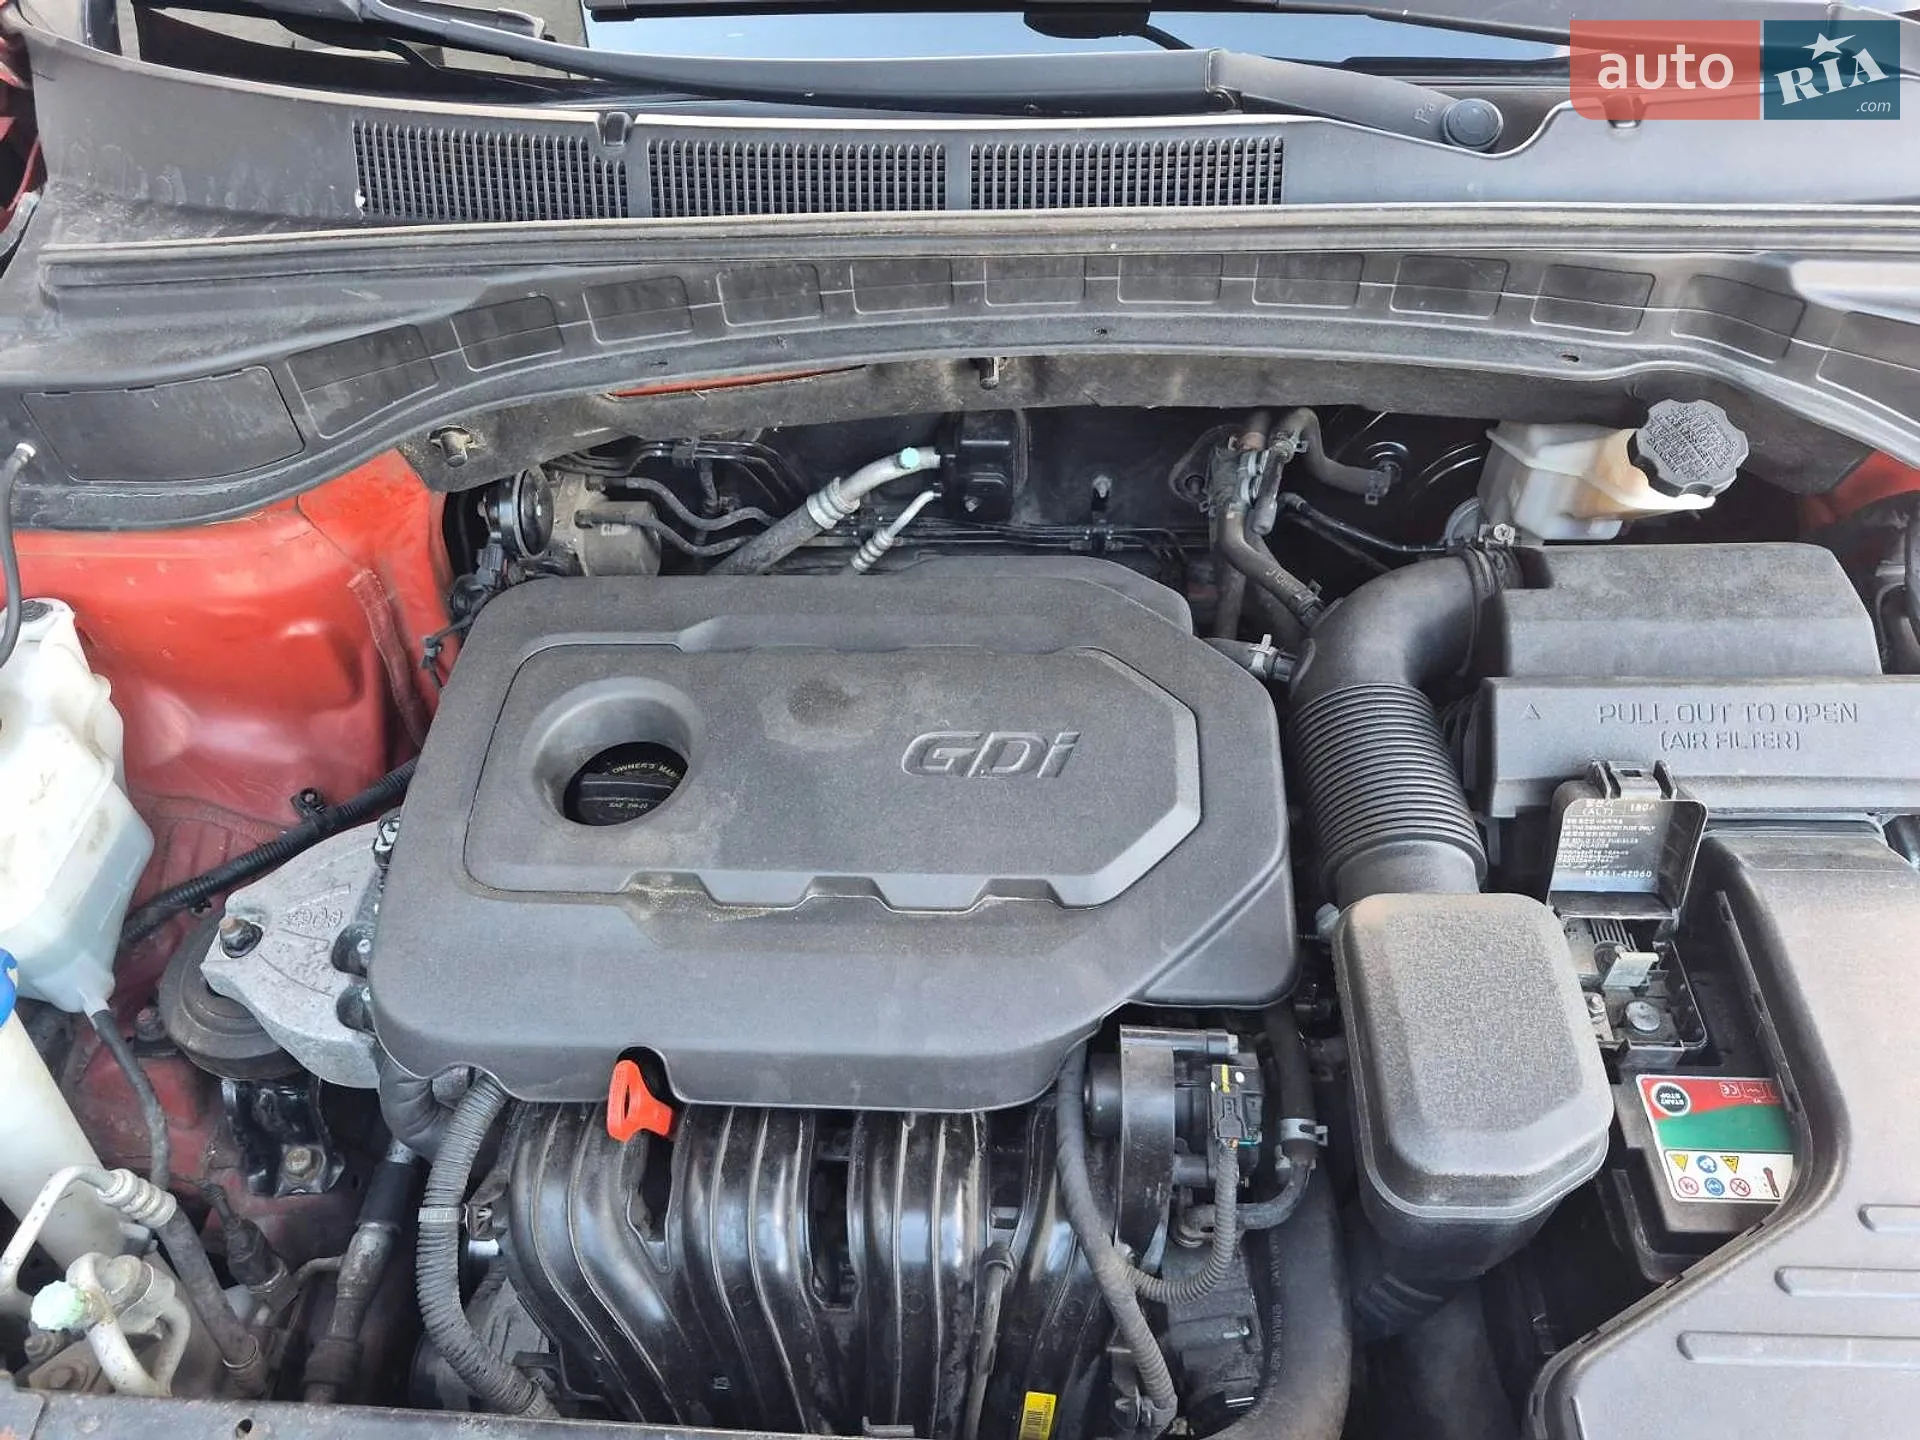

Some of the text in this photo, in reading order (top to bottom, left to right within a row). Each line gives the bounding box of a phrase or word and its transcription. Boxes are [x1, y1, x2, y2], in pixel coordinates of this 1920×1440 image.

[1599, 702, 1859, 724] PULL OUT TO OPEN
[902, 731, 1082, 778] GDi
